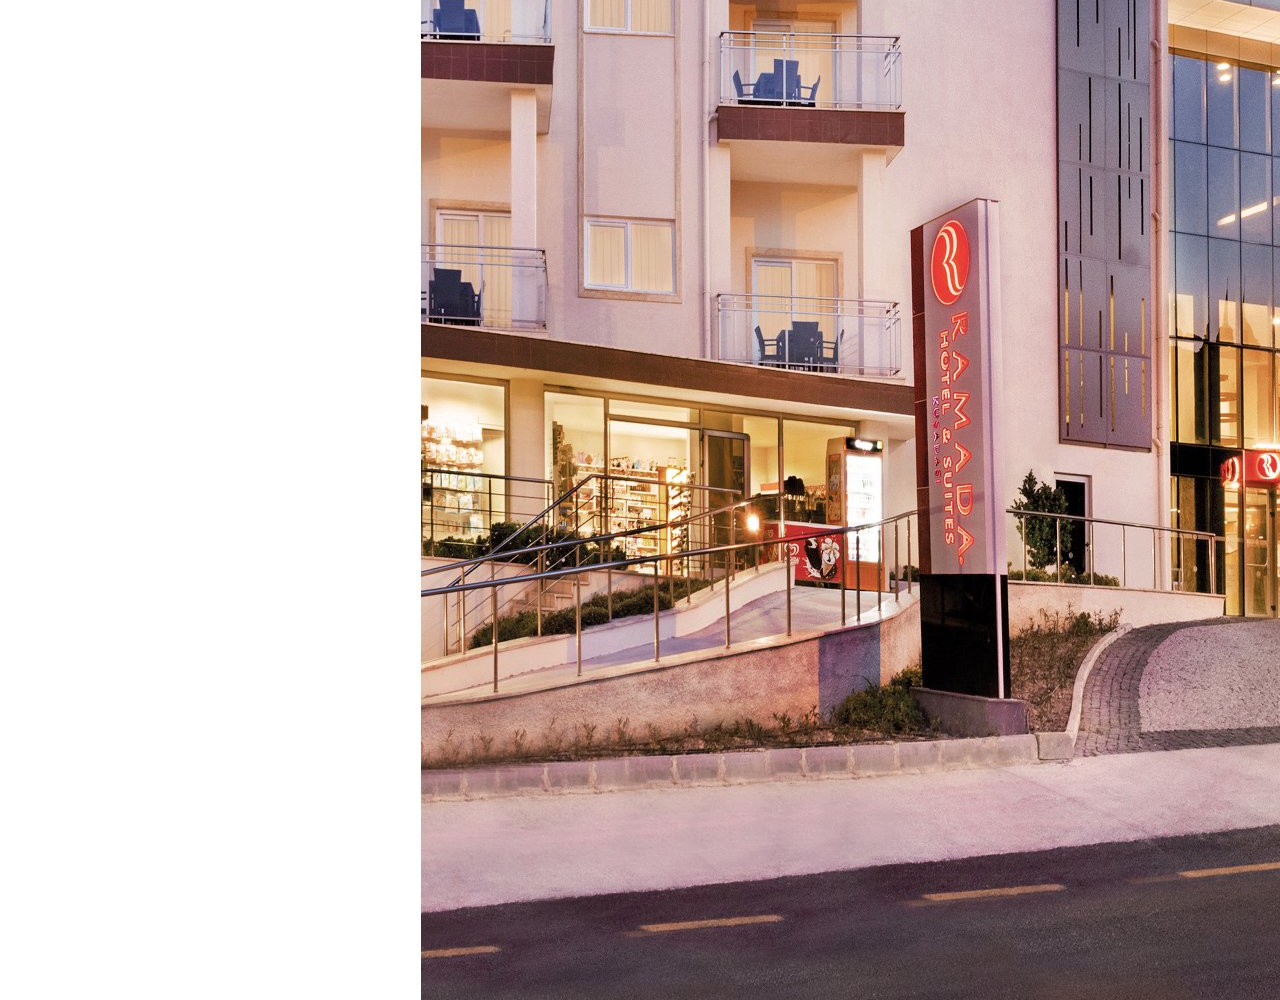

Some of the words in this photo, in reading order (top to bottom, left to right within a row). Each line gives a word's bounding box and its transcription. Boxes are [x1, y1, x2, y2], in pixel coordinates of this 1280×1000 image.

[940, 331, 951, 416] HOTEL
[941, 428, 951, 444] &
[952, 312, 974, 558] RAMADA
[943, 456, 954, 545] SUITES
